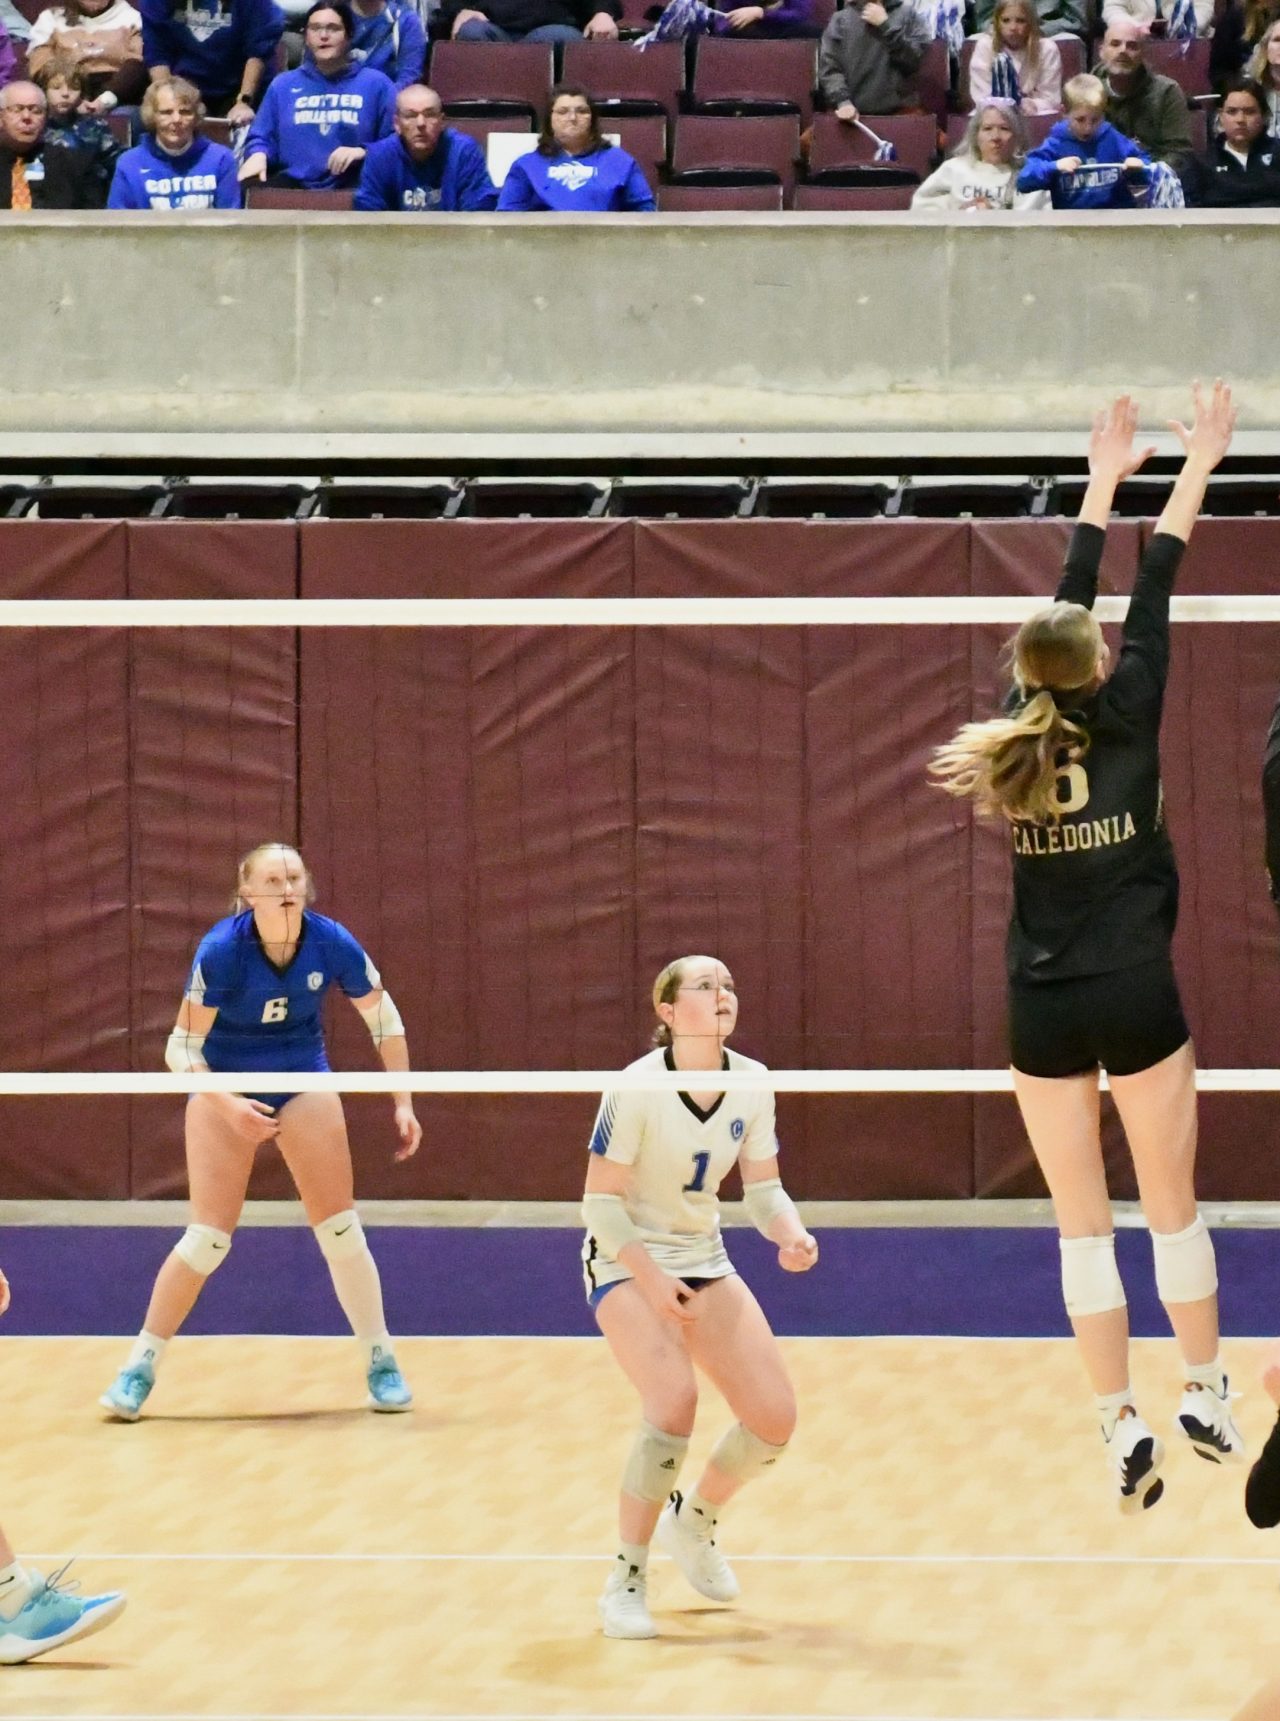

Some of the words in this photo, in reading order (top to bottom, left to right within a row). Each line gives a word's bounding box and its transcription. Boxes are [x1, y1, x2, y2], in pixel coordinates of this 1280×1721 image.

[294, 93, 363, 109] COTTER
[145, 174, 217, 195] COTTER
[1013, 812, 1136, 855] CALEDONIA
[261, 996, 289, 1024] 6
[682, 1149, 711, 1193] 1
